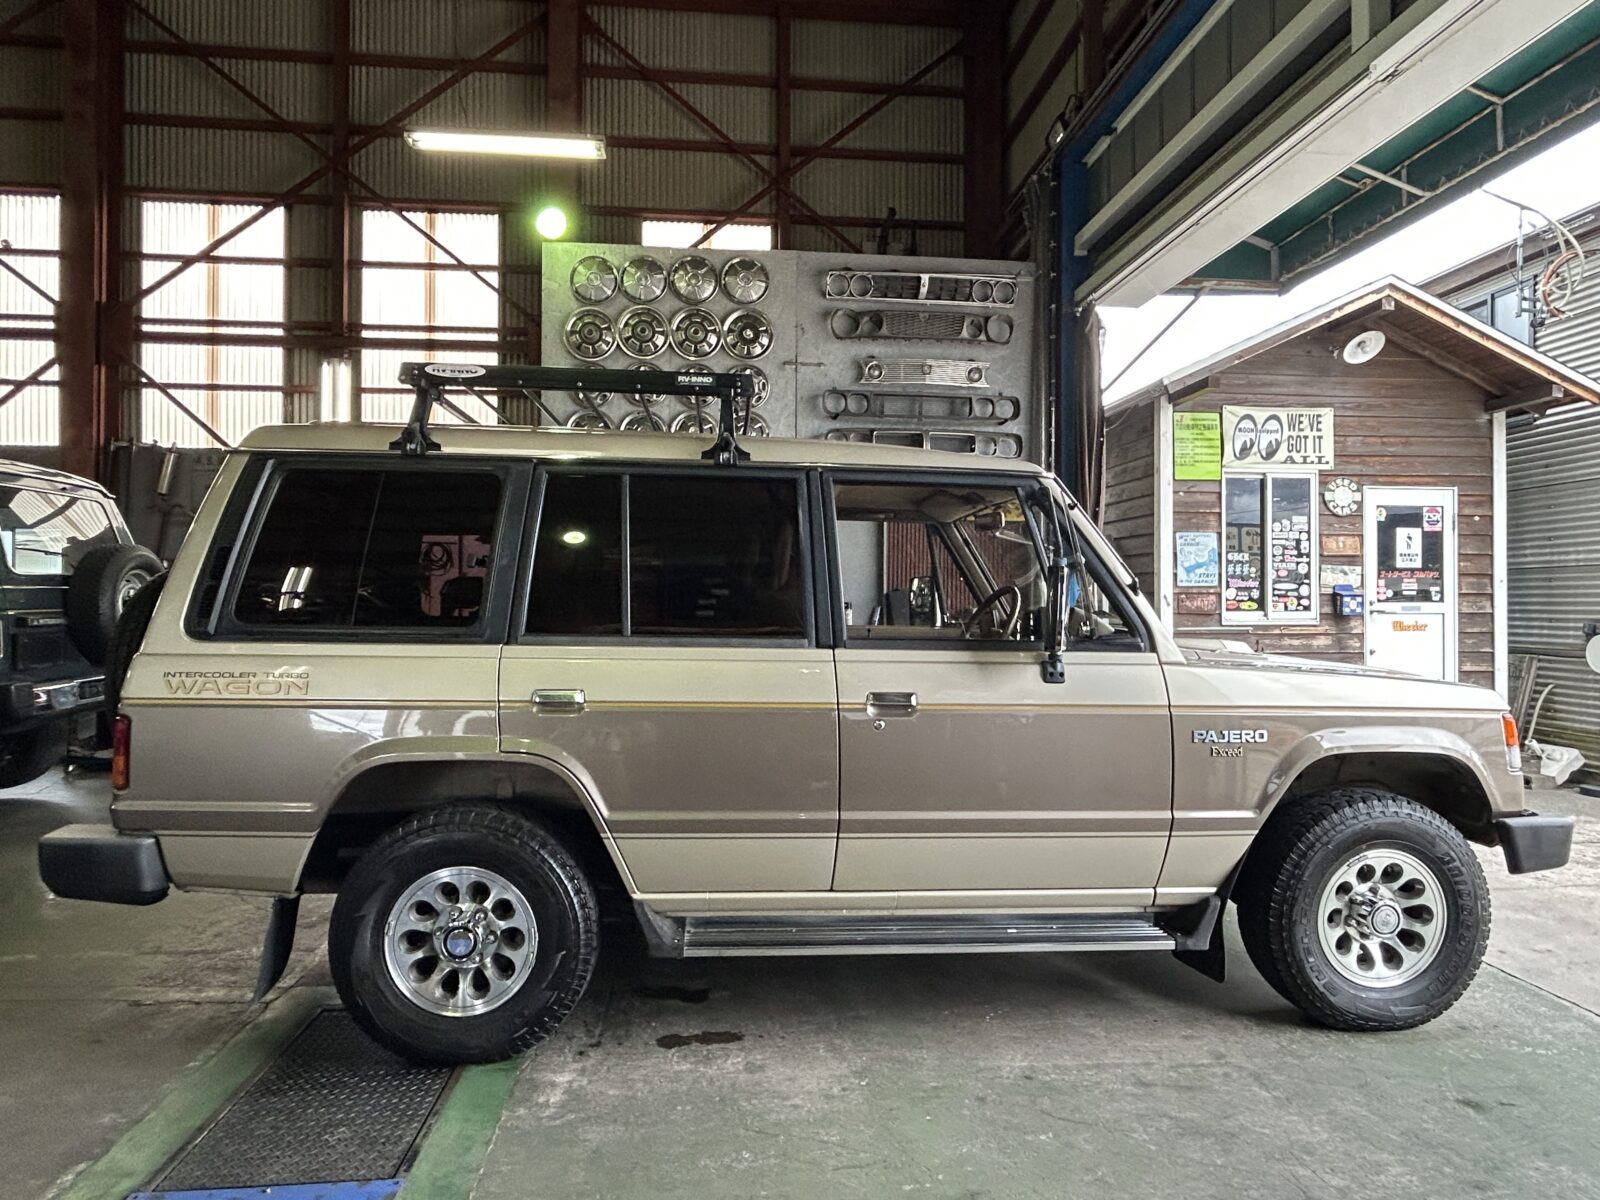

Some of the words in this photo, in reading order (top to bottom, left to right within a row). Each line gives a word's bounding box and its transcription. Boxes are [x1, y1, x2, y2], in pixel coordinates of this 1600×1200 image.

[1286, 413, 1322, 432] WE'VE
[1286, 435, 1309, 454] GOT
[1312, 435, 1323, 454] IT
[1280, 455, 1330, 465] ALL
[1328, 478, 1358, 491] USED
[1328, 502, 1358, 515] CARS
[163, 671, 257, 679] INTERCOOLER
[164, 679, 310, 695] WAGON
[1191, 729, 1269, 743] PAJERO
[1210, 746, 1244, 757] Exceed
